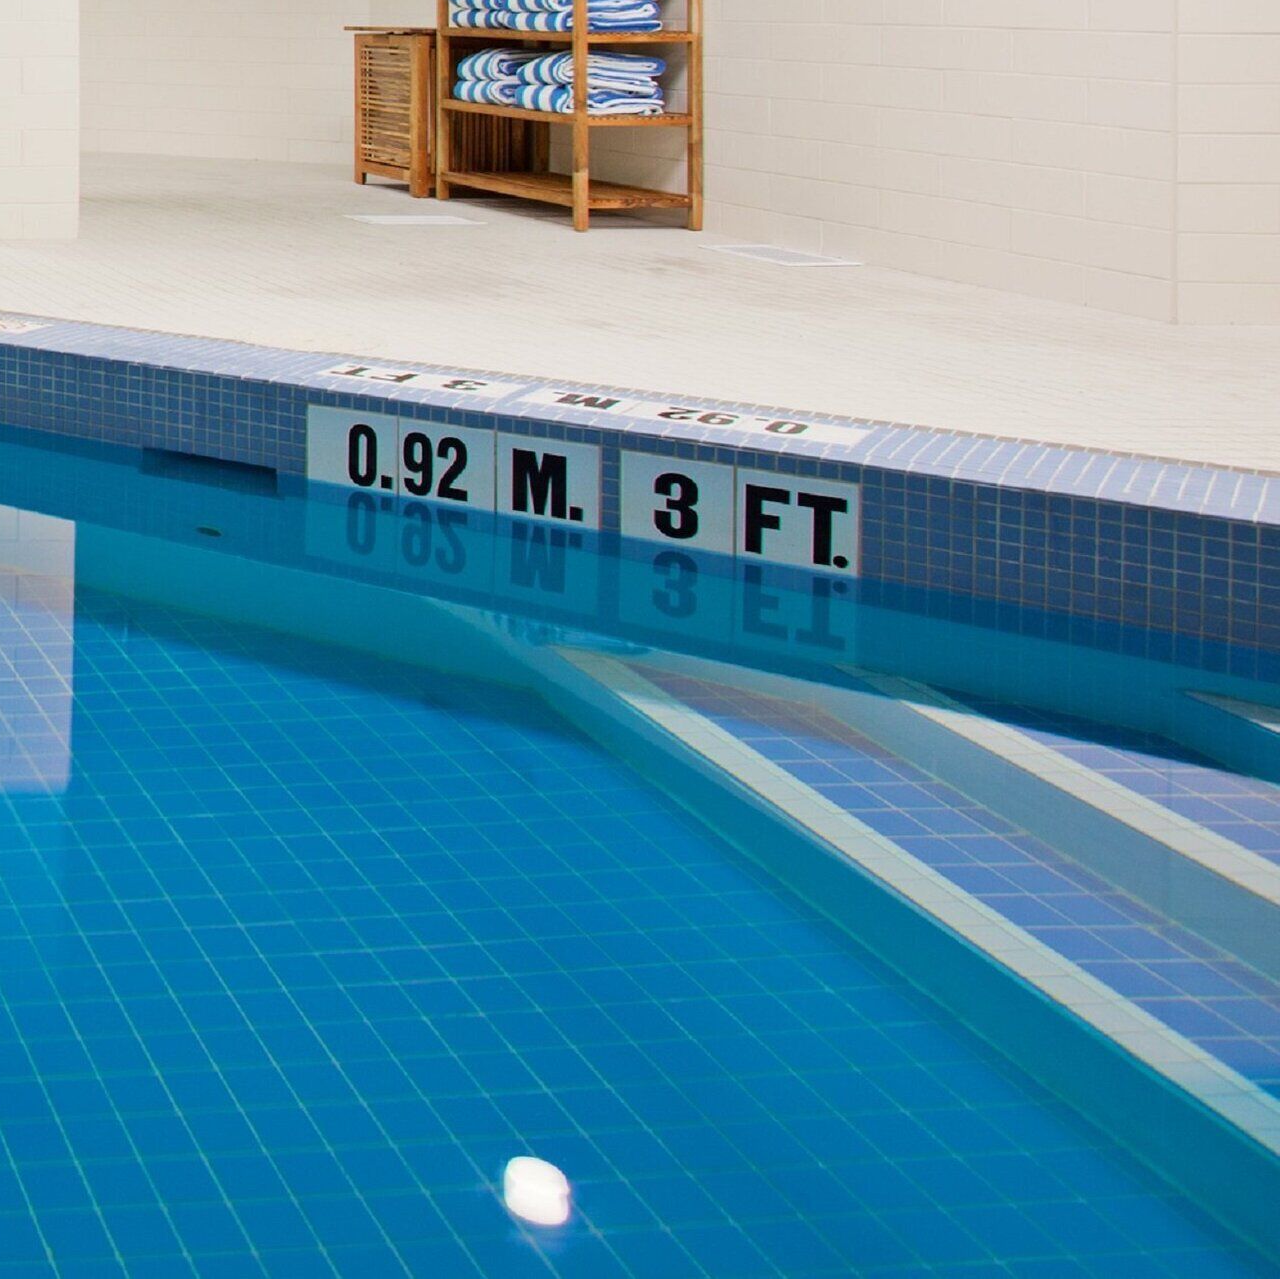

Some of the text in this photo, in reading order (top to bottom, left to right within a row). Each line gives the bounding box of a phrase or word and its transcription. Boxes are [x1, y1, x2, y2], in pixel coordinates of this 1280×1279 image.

[441, 378, 488, 391] 3
[554, 391, 621, 410] M.
[658, 405, 809, 435] 0.92
[347, 423, 850, 570] 0.92 M. 3 FT.
